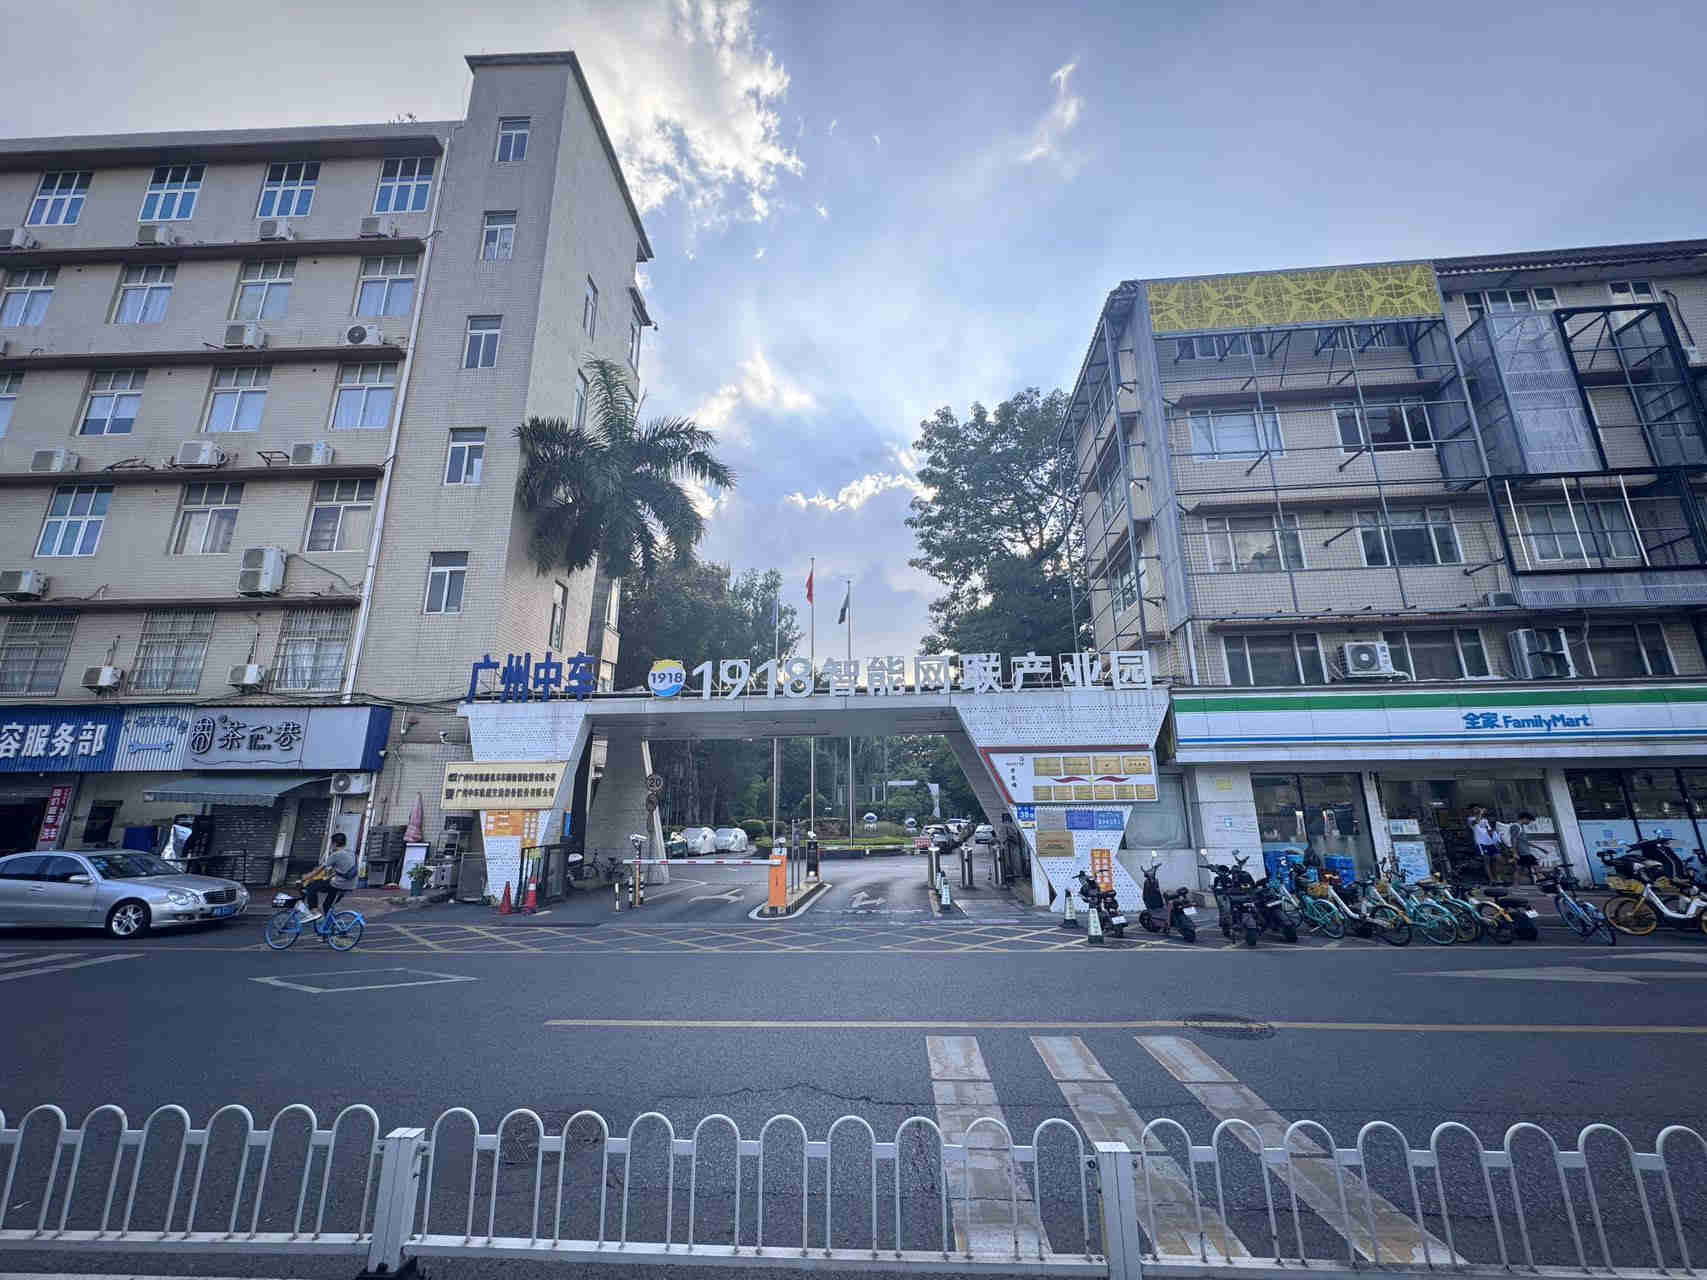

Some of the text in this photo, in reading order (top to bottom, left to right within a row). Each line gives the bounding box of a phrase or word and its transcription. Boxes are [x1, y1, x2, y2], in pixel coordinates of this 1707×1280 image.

[465, 651, 595, 702] 广州中车
[651, 672, 683, 684] 1918
[1462, 712, 1592, 731] 全家 FamilyMart
[0, 721, 108, 758] 容服务部
